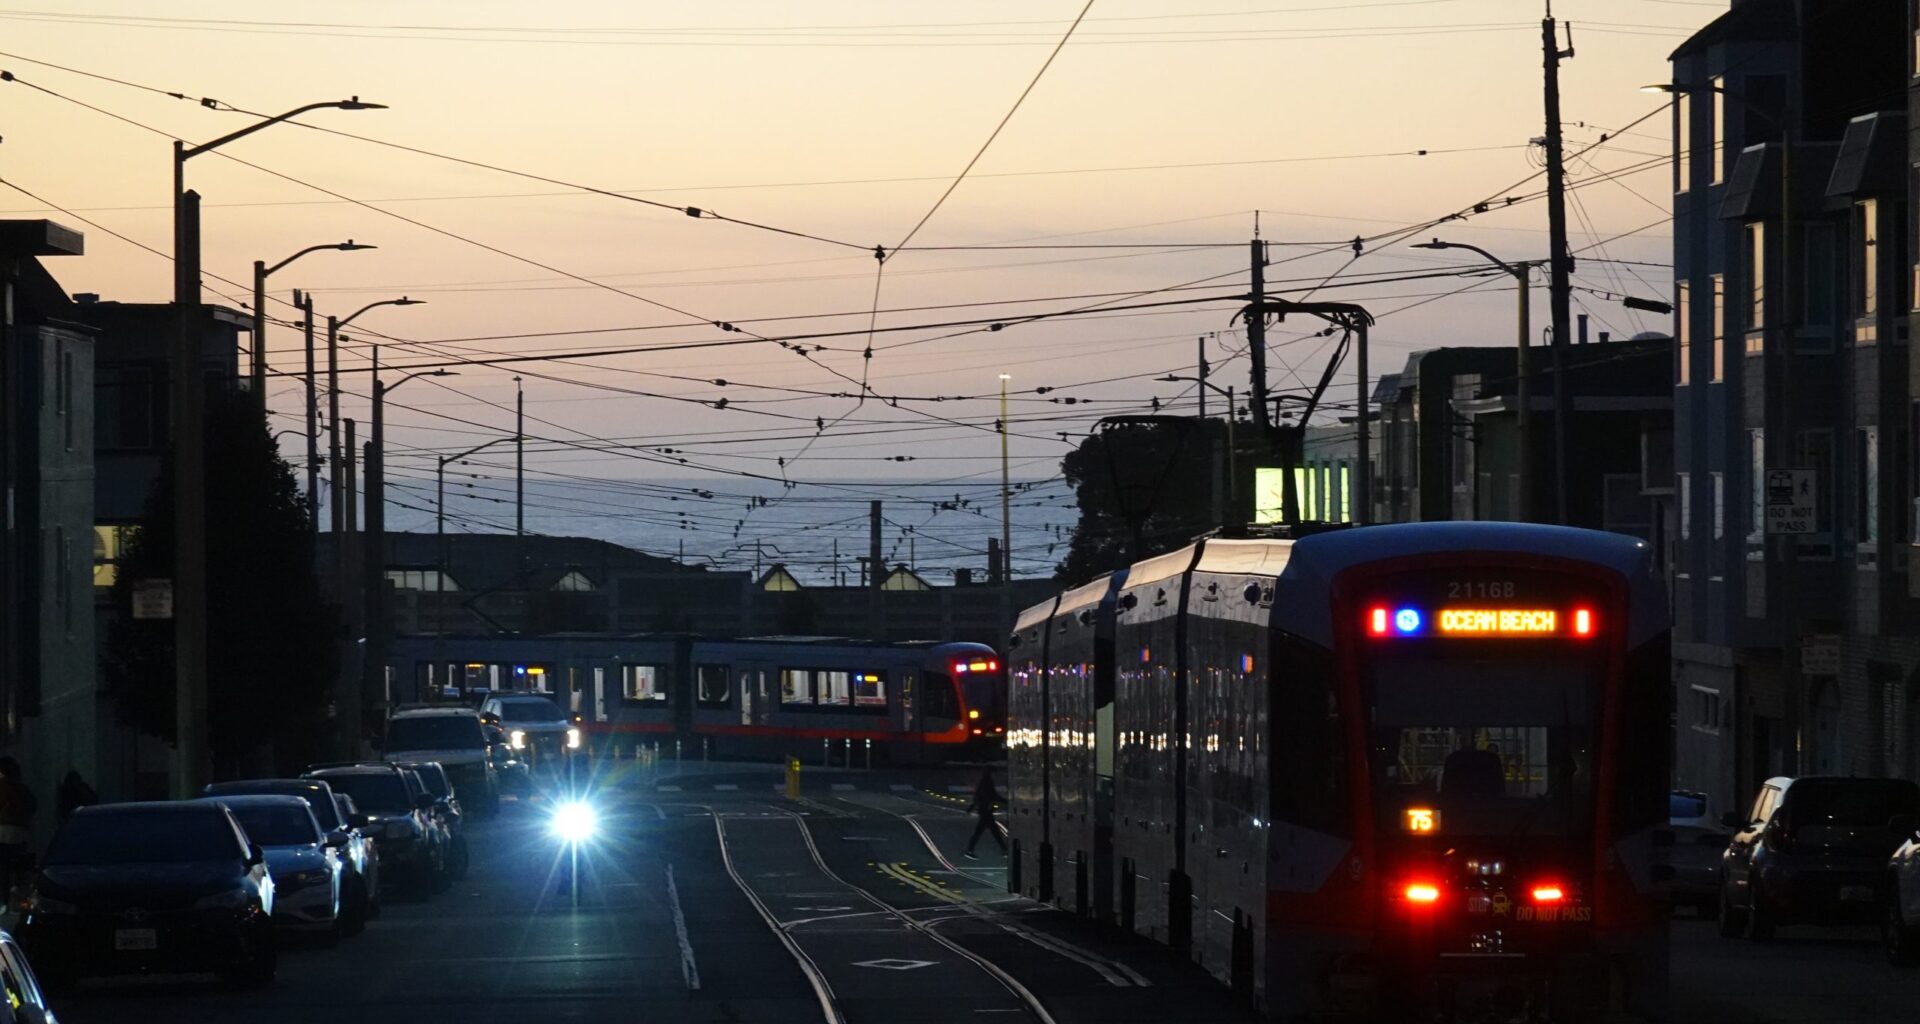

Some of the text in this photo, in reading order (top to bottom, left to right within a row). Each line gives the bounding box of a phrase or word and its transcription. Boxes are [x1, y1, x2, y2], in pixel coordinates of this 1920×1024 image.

[1770, 508, 1812, 517] DO NOT
[1777, 521, 1807, 531] PASS
[1448, 581, 1515, 598] 2116B
[1441, 610, 1496, 631] OCEAN
[1499, 610, 1555, 631] BEACH
[1407, 809, 1433, 831] 75
[1517, 906, 1591, 921] DO NOT PASS
